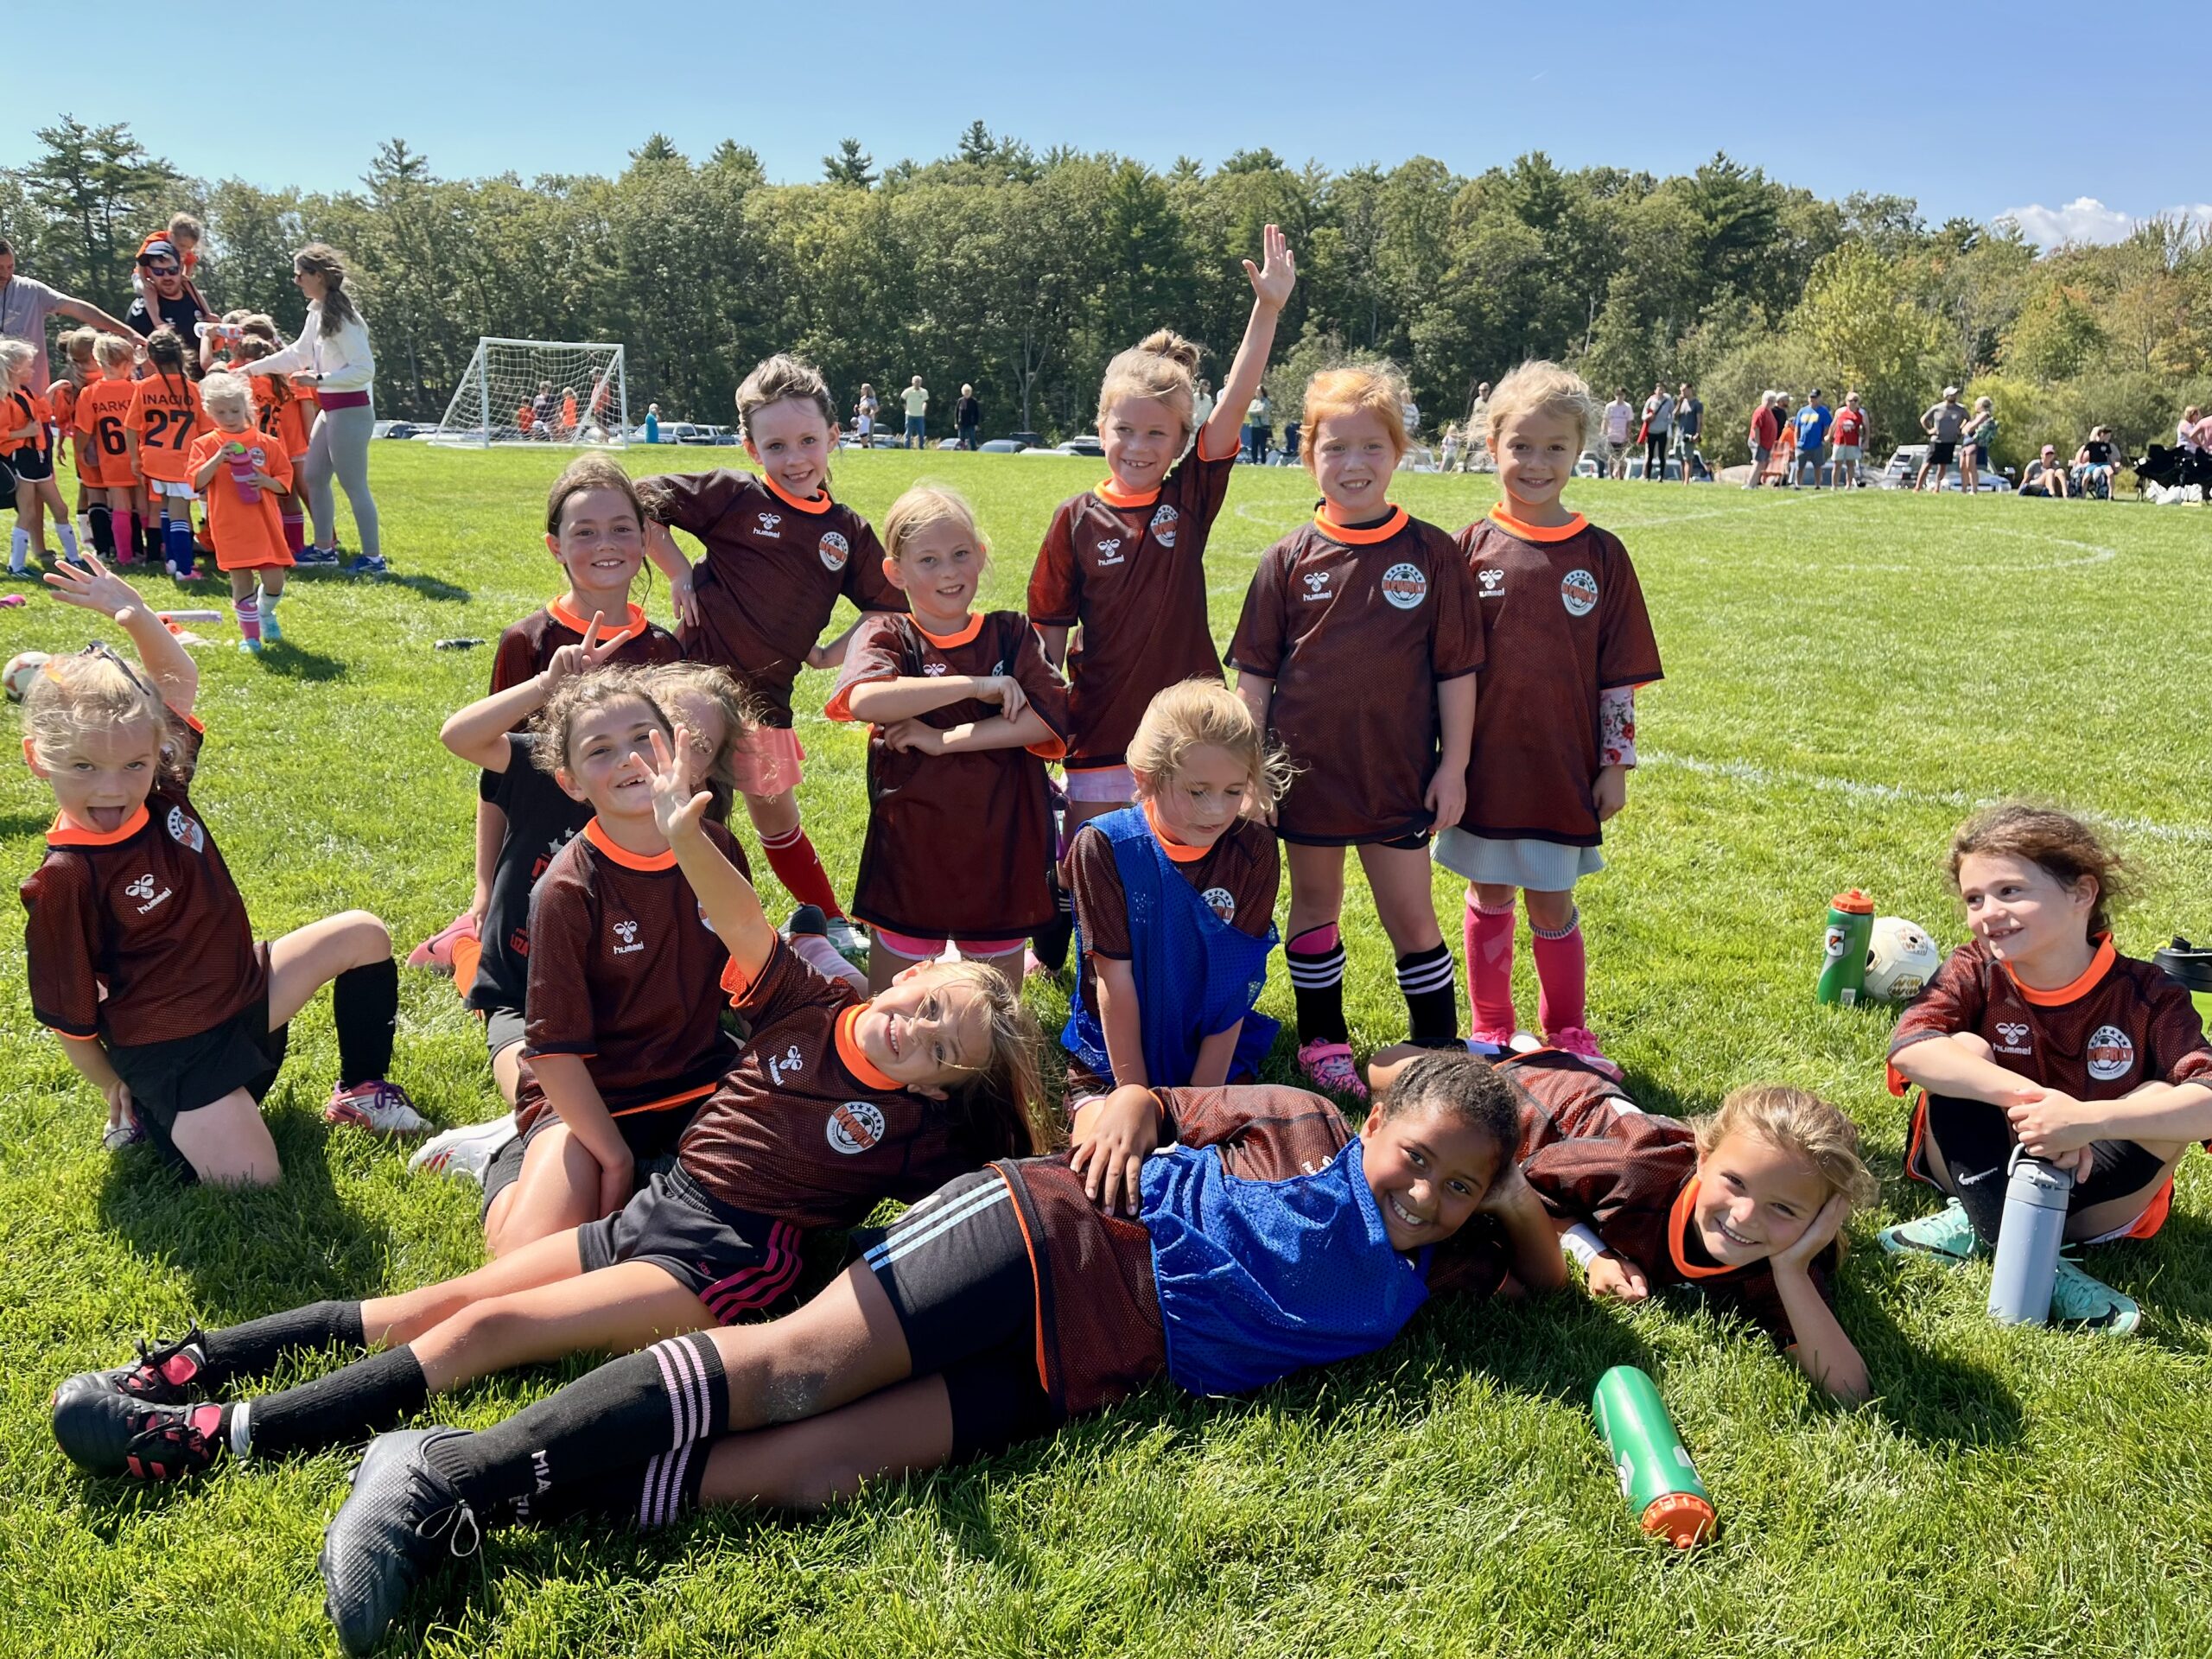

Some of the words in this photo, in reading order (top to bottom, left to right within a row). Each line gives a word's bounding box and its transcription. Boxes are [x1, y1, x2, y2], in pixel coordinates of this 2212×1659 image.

[99, 416, 126, 454] 6
[144, 410, 194, 450] 27
[753, 527, 780, 538] hummel
[1478, 587, 1505, 598] ummel
[137, 887, 173, 914] hummel
[613, 941, 644, 955] hummel
[1993, 1042, 2031, 1055] hummel
[768, 1054, 785, 1086] hummel
[531, 1449, 552, 1494] MIA
